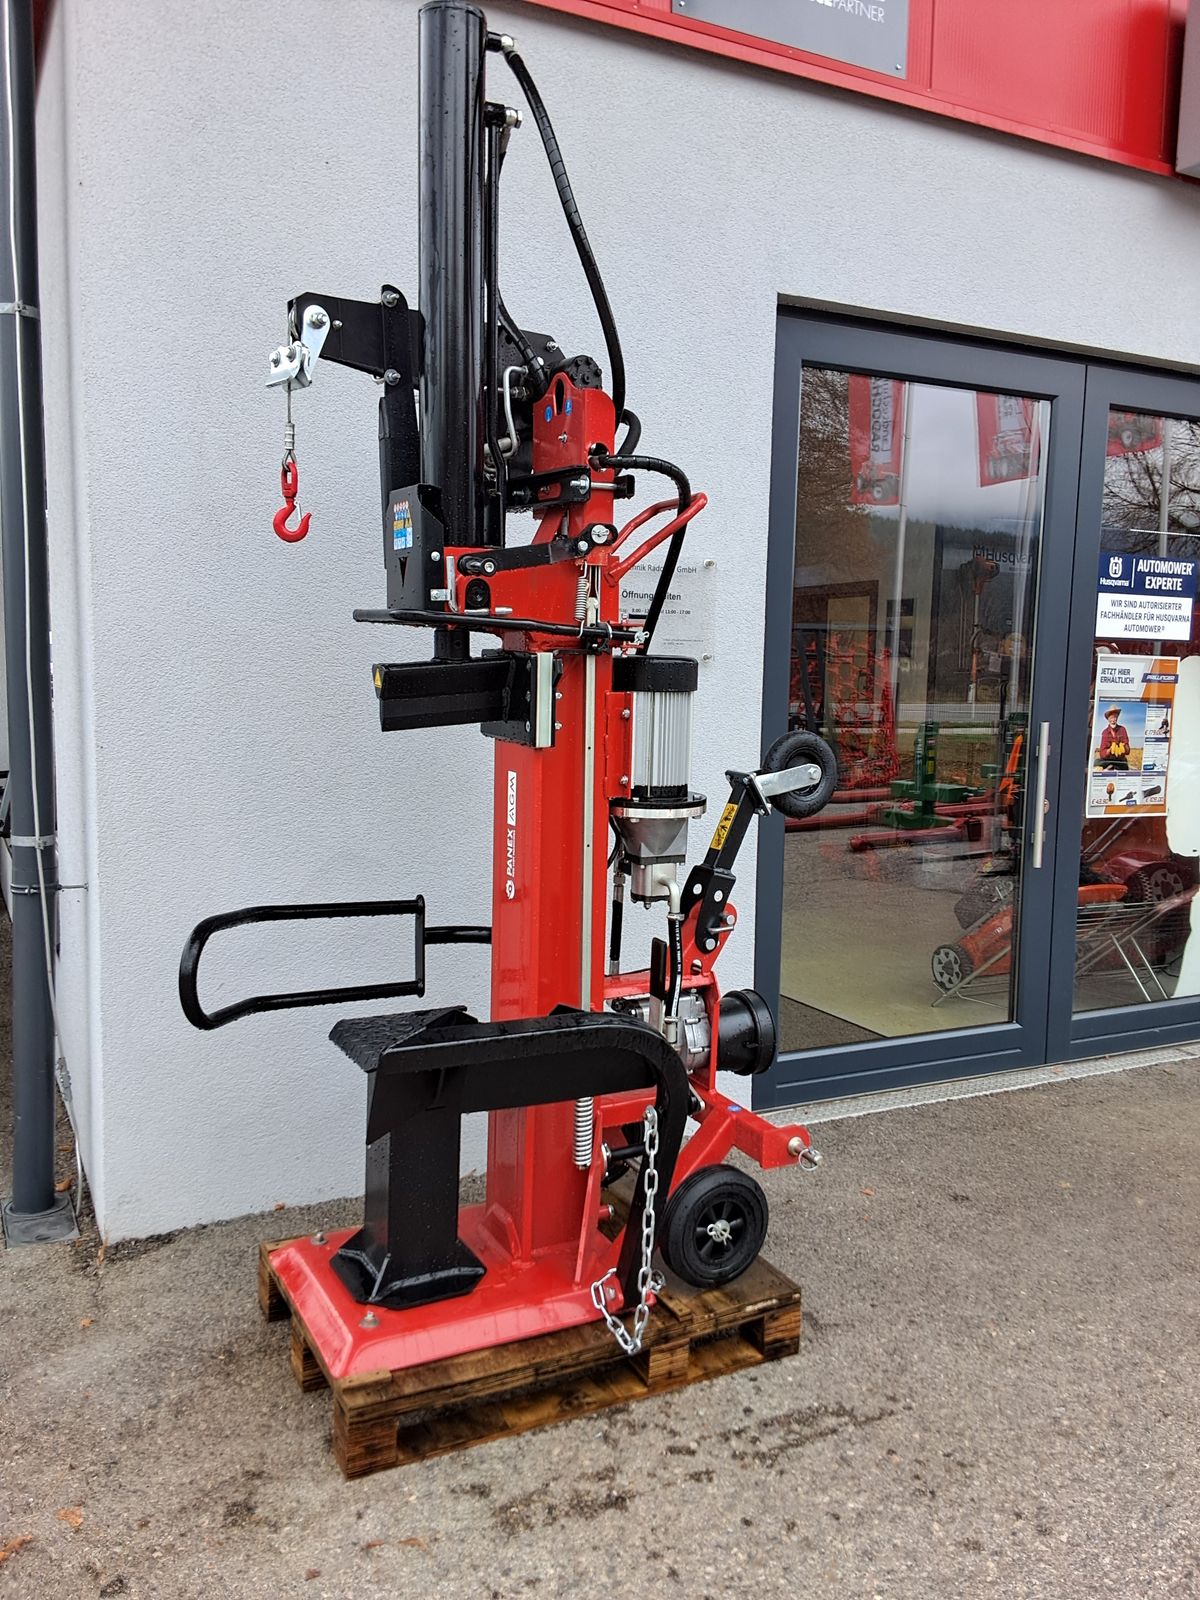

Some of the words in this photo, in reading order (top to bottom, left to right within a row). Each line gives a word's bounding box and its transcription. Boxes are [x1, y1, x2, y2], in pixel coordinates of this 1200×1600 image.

[1099, 577, 1129, 587] Husqvarna
[1144, 576, 1183, 591] EXPERTE
[1111, 599, 1123, 608] WIR
[1123, 600, 1138, 609] SIND
[1138, 601, 1182, 611] AUTORISIERTER
[1100, 610, 1143, 621] FACHHÄNDLER
[1143, 612, 1155, 621] FÜR
[1155, 613, 1190, 623] HUSQVARNA
[1100, 667, 1117, 676] JETZT
[1117, 668, 1131, 676] HIER
